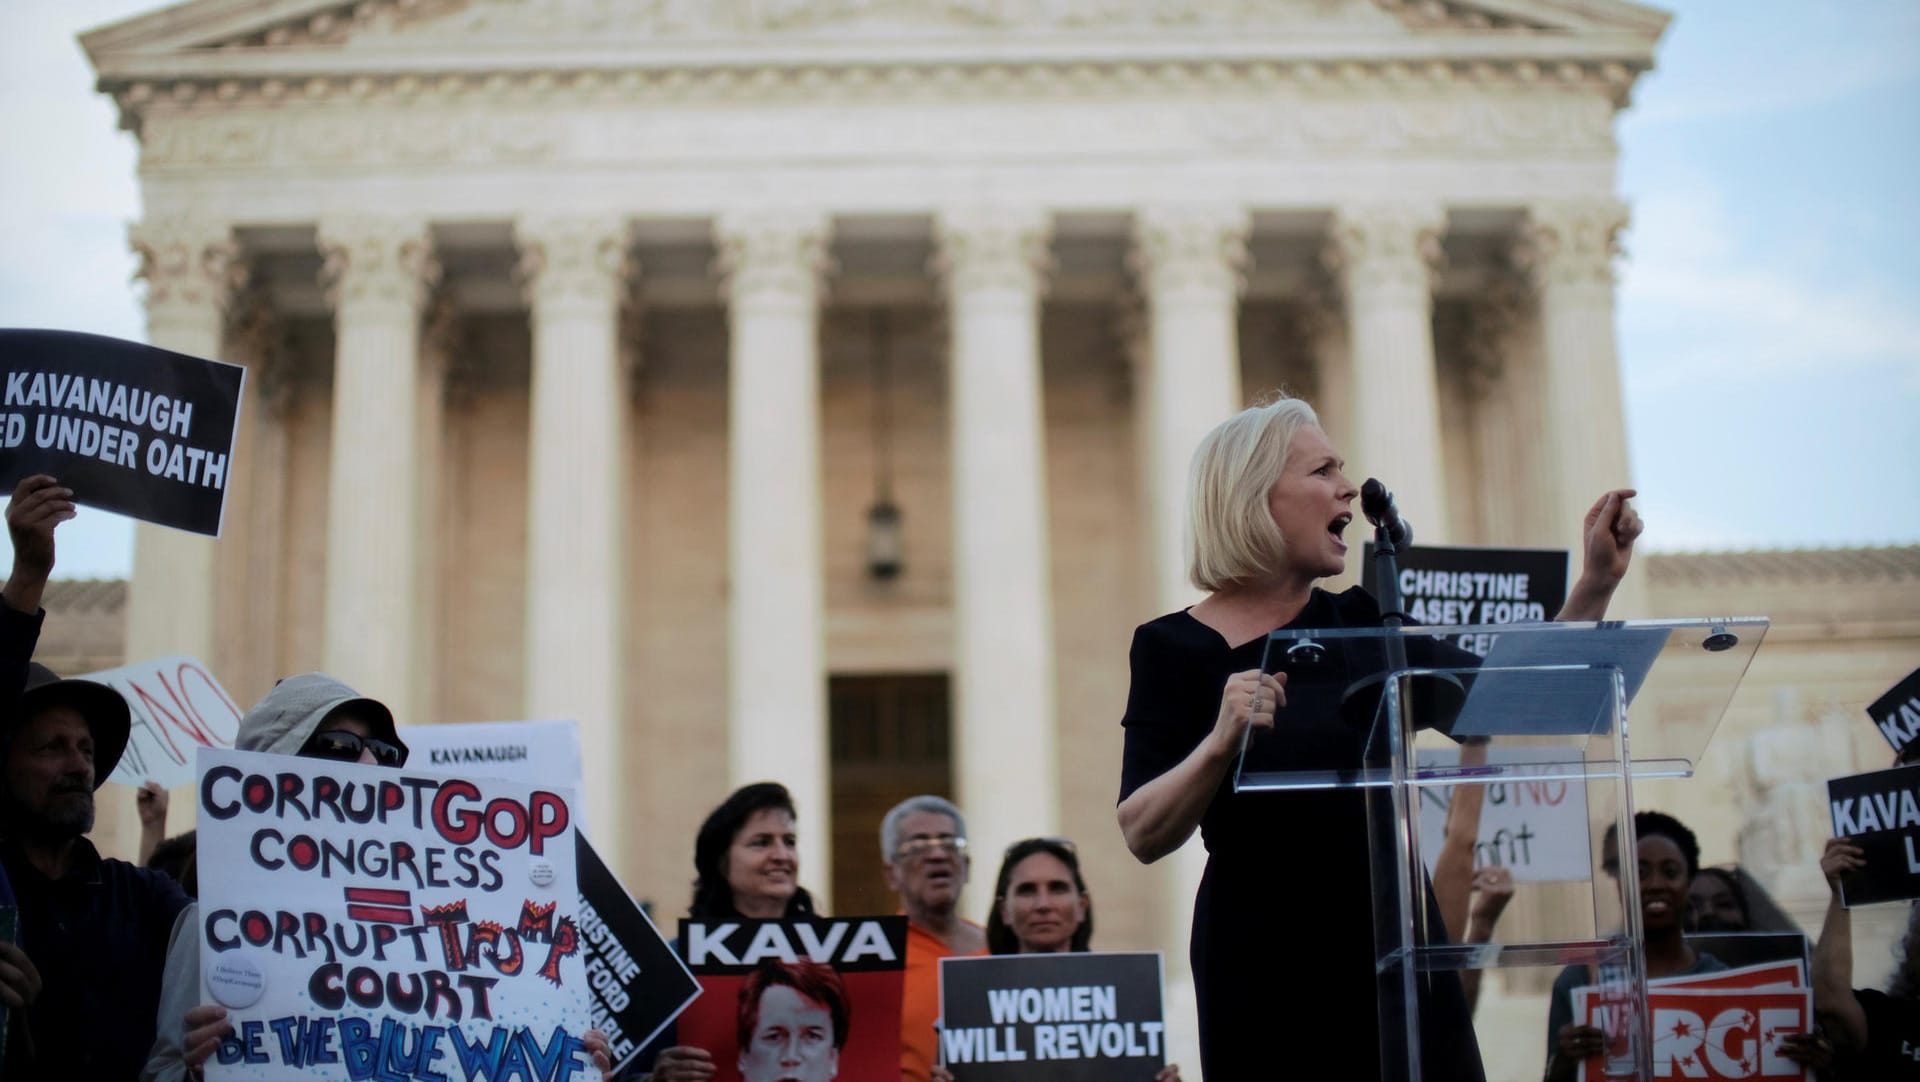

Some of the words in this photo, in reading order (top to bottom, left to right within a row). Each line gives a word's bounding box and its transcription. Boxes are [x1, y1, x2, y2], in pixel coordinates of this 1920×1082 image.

[5, 372, 193, 438] KAVANAUGH
[35, 414, 139, 469] UNDER
[146, 438, 226, 489] OATH
[1400, 569, 1529, 600] CHRISTINE
[1401, 597, 1476, 625] ASEY
[1480, 602, 1545, 625] FORD
[430, 745, 528, 765] KAVANAUGH
[201, 765, 440, 829] CORRUPT
[431, 779, 569, 856] GOP
[250, 828, 503, 892] CONGRESS
[205, 909, 430, 962] CORRUPT
[578, 895, 641, 985] HRISTINE
[687, 921, 897, 966] KAVA
[308, 963, 500, 1023] COURT
[586, 959, 631, 1014] FORD
[987, 985, 1117, 1025] WOMEN
[216, 1020, 270, 1065] BE
[269, 1016, 339, 1070] THE
[337, 1016, 448, 1082] BLUE
[447, 1023, 585, 1082] WAVE
[944, 1026, 1027, 1064] WILL
[1034, 1021, 1163, 1061] REVOLT
